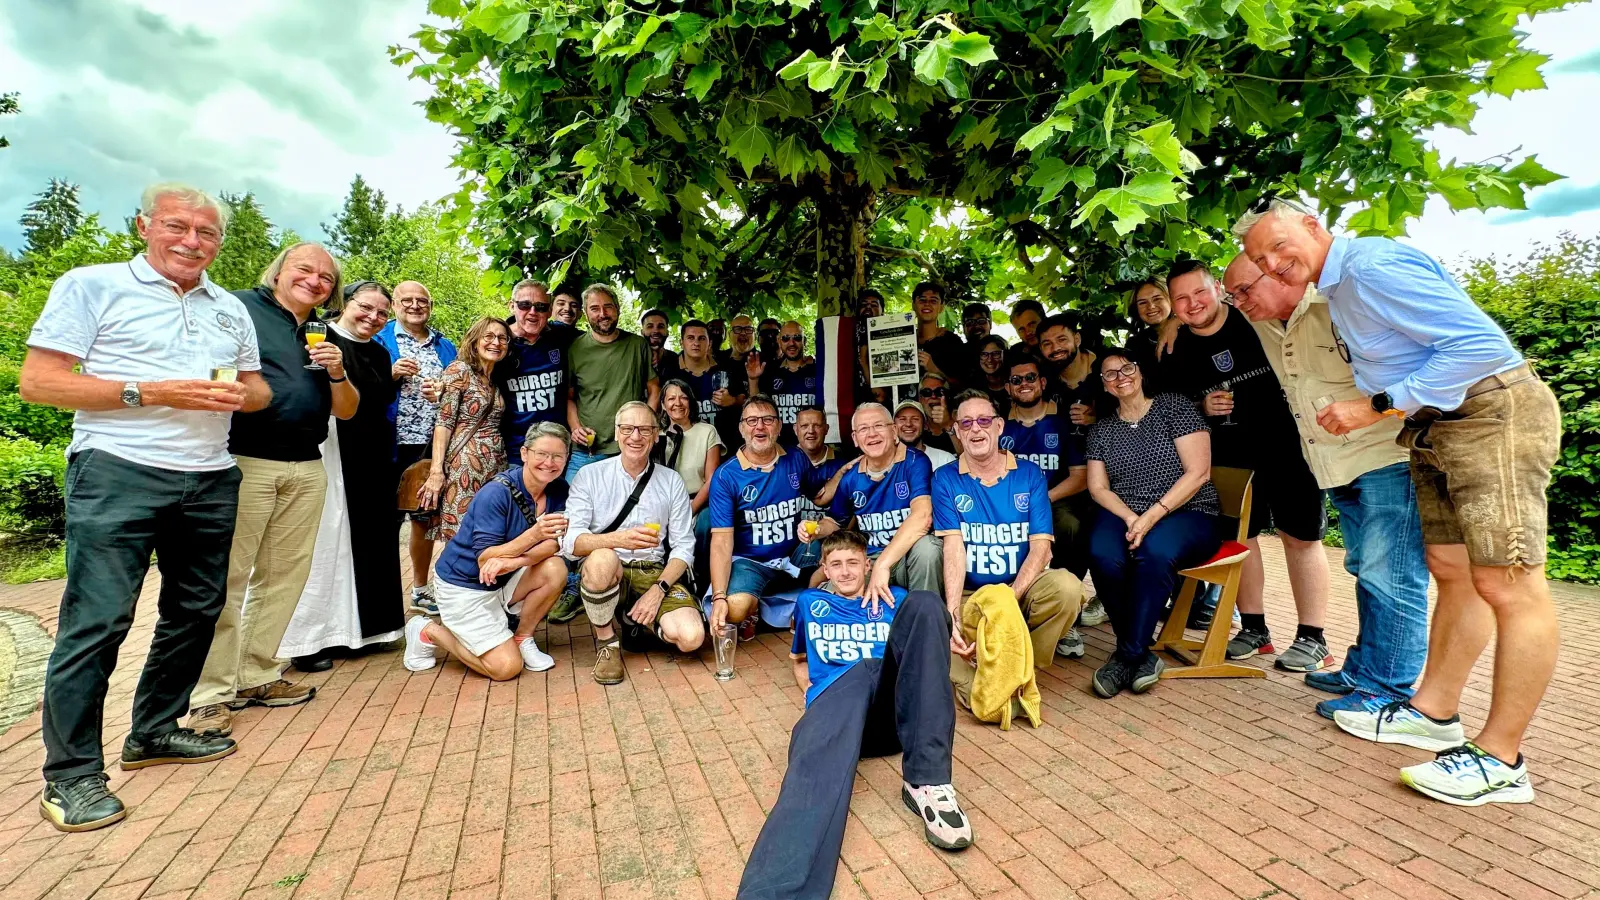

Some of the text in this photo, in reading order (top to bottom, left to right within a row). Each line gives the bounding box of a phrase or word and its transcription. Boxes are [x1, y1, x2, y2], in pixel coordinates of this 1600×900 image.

[507, 370, 563, 391] BÜRGER
[516, 387, 556, 412] FEST
[772, 393, 816, 407] BÜRGER
[779, 407, 803, 424] FES
[752, 517, 795, 545] FEST
[965, 544, 1020, 575] FEST
[808, 621, 891, 643] BÜRGER
[815, 639, 875, 664] FEST
